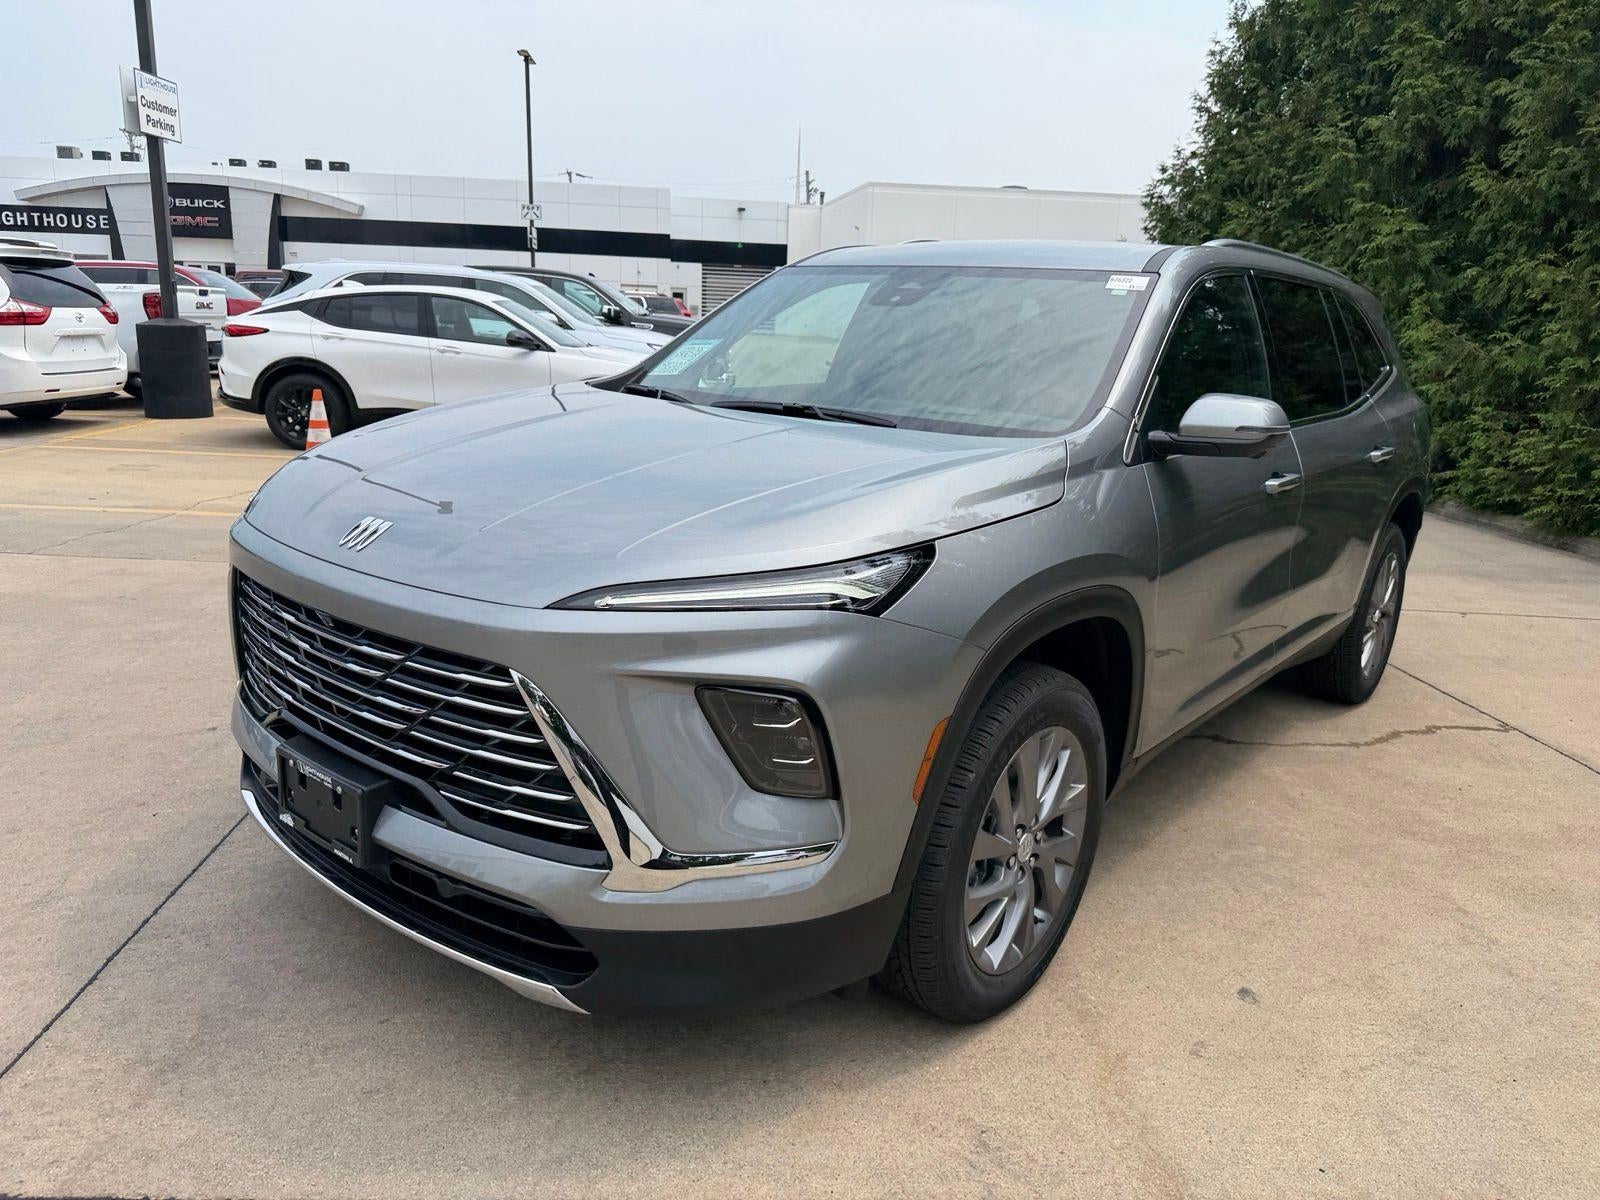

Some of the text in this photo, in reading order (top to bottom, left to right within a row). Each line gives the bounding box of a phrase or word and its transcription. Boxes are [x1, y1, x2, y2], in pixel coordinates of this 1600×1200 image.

[145, 76, 177, 94] LIGHTHOUSE
[140, 94, 177, 117] Customer
[146, 113, 176, 136] Parking
[175, 198, 226, 208] BUICK
[0, 211, 110, 229] GHTHOUSE
[169, 215, 219, 227] GMC
